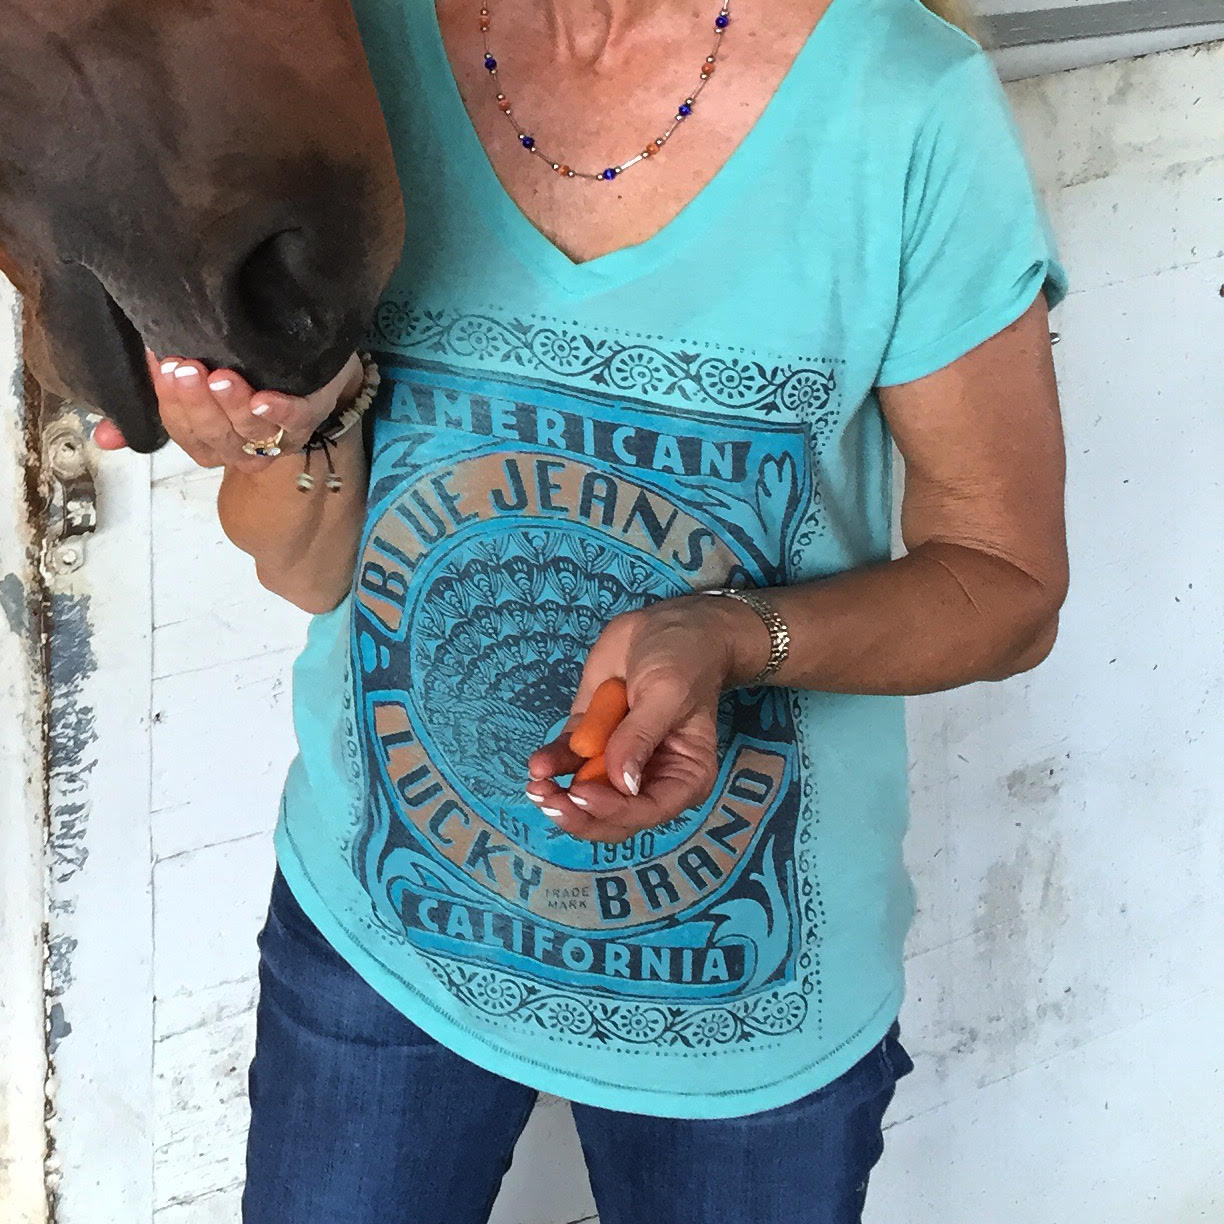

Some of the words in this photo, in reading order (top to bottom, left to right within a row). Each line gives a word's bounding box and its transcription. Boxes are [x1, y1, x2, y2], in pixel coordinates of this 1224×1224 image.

[389, 384, 736, 480] AMERICAN
[358, 470, 479, 610] BLUE
[490, 458, 717, 573] JEANS
[379, 730, 543, 903] LUCKY
[595, 766, 775, 922] BRAND
[590, 831, 656, 866] 1990
[544, 886, 591, 898] TRADE
[548, 899, 589, 910] MARK
[416, 898, 732, 983] CALIFORNIA
